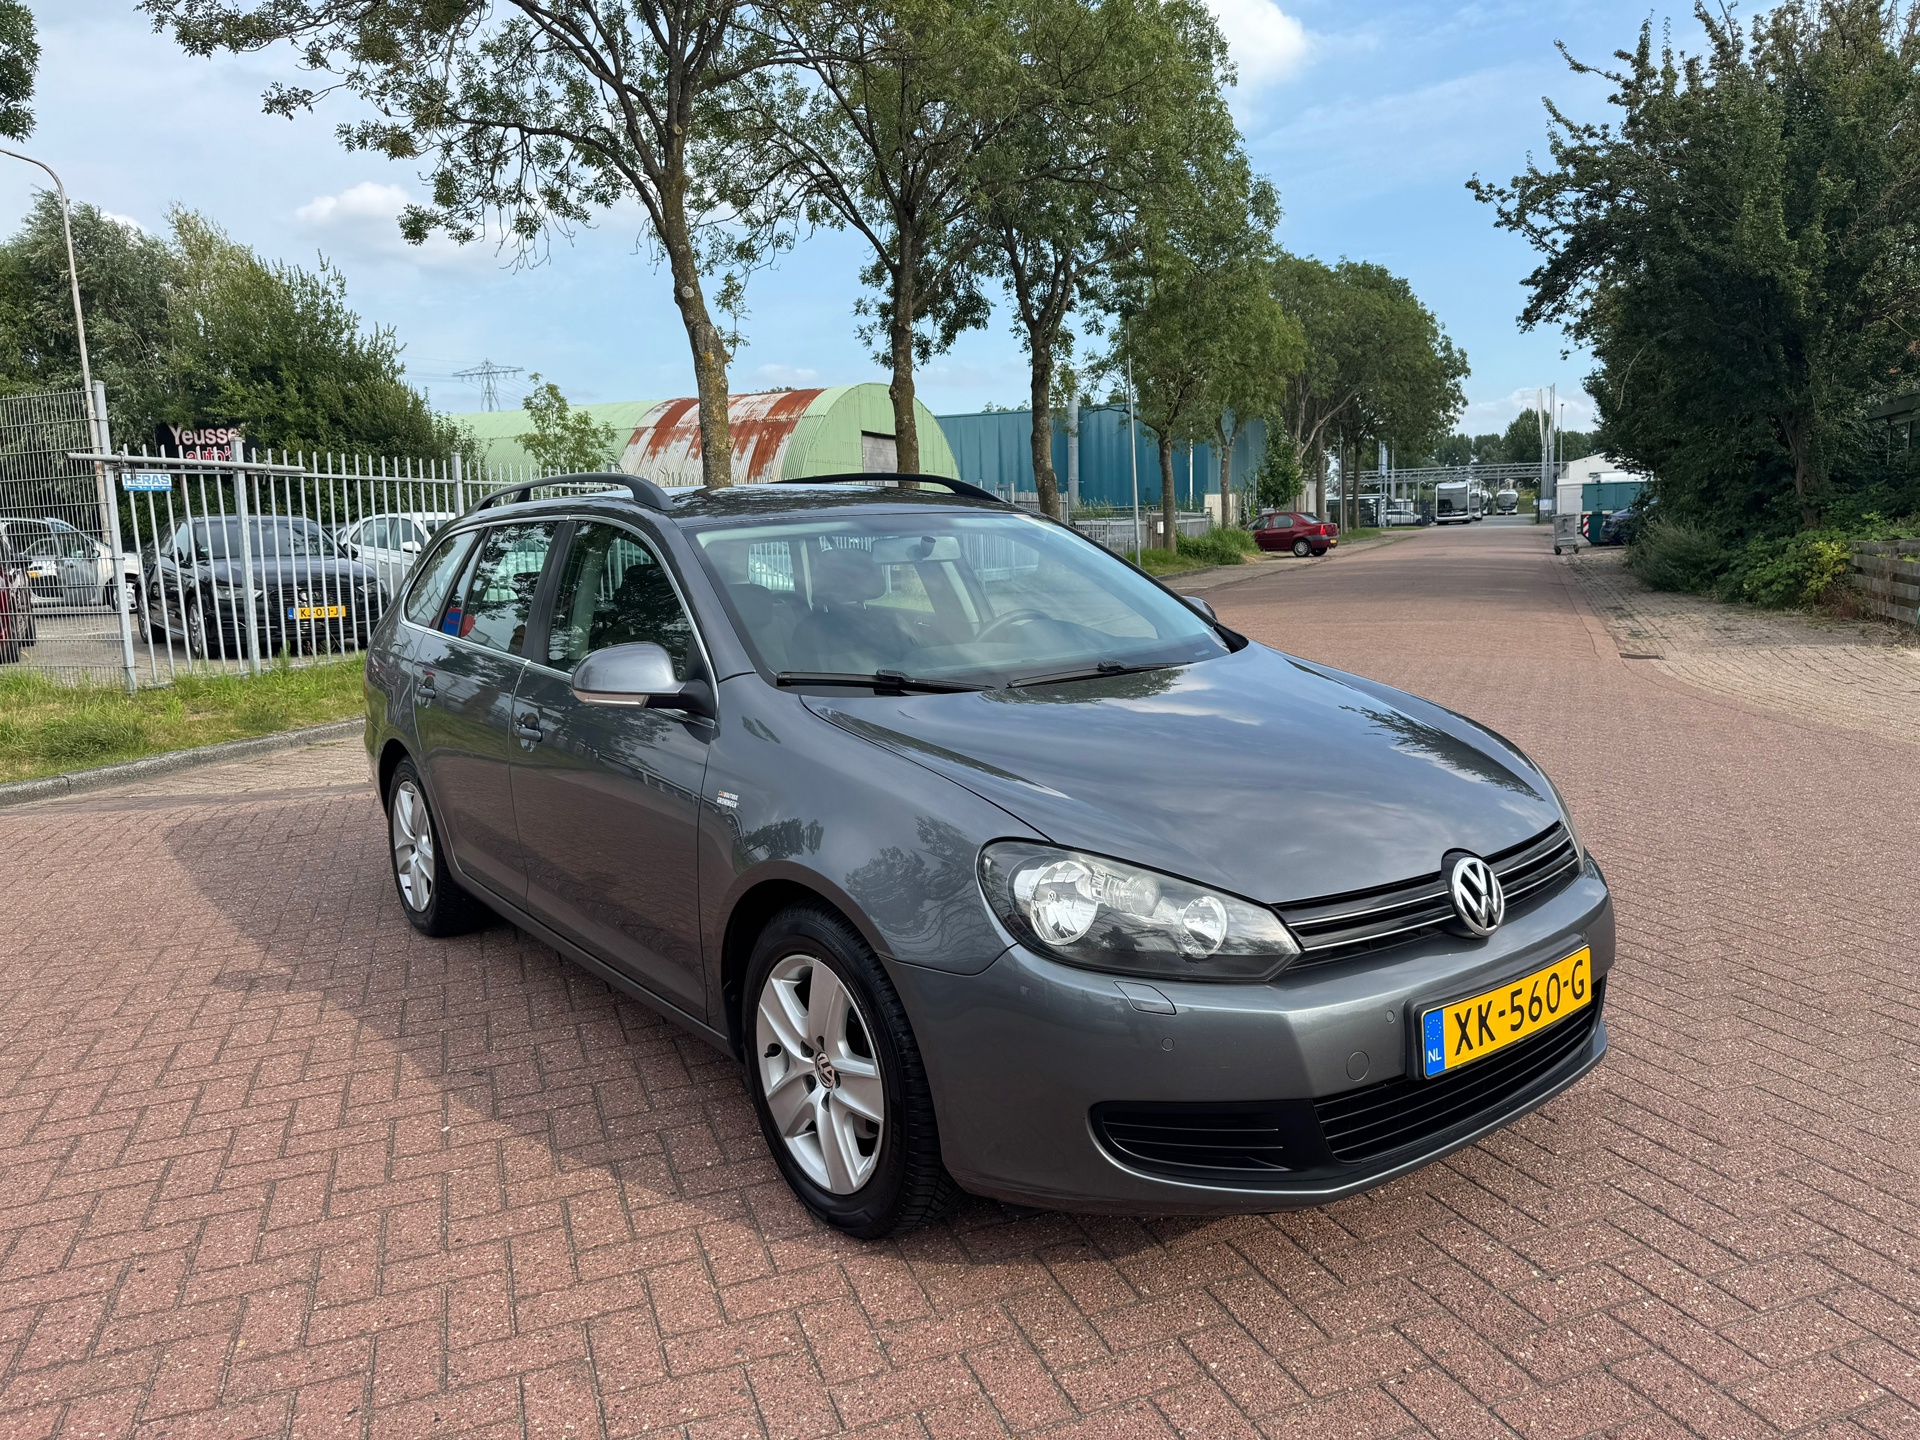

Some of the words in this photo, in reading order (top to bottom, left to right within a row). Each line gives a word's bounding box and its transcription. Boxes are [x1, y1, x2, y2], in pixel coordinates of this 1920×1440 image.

[168, 425, 246, 445] Yeusse
[123, 474, 170, 485] HERAS
[1452, 857, 1504, 936] VW
[1454, 959, 1585, 1057] XK-560-G
[1427, 1048, 1442, 1063] NL
